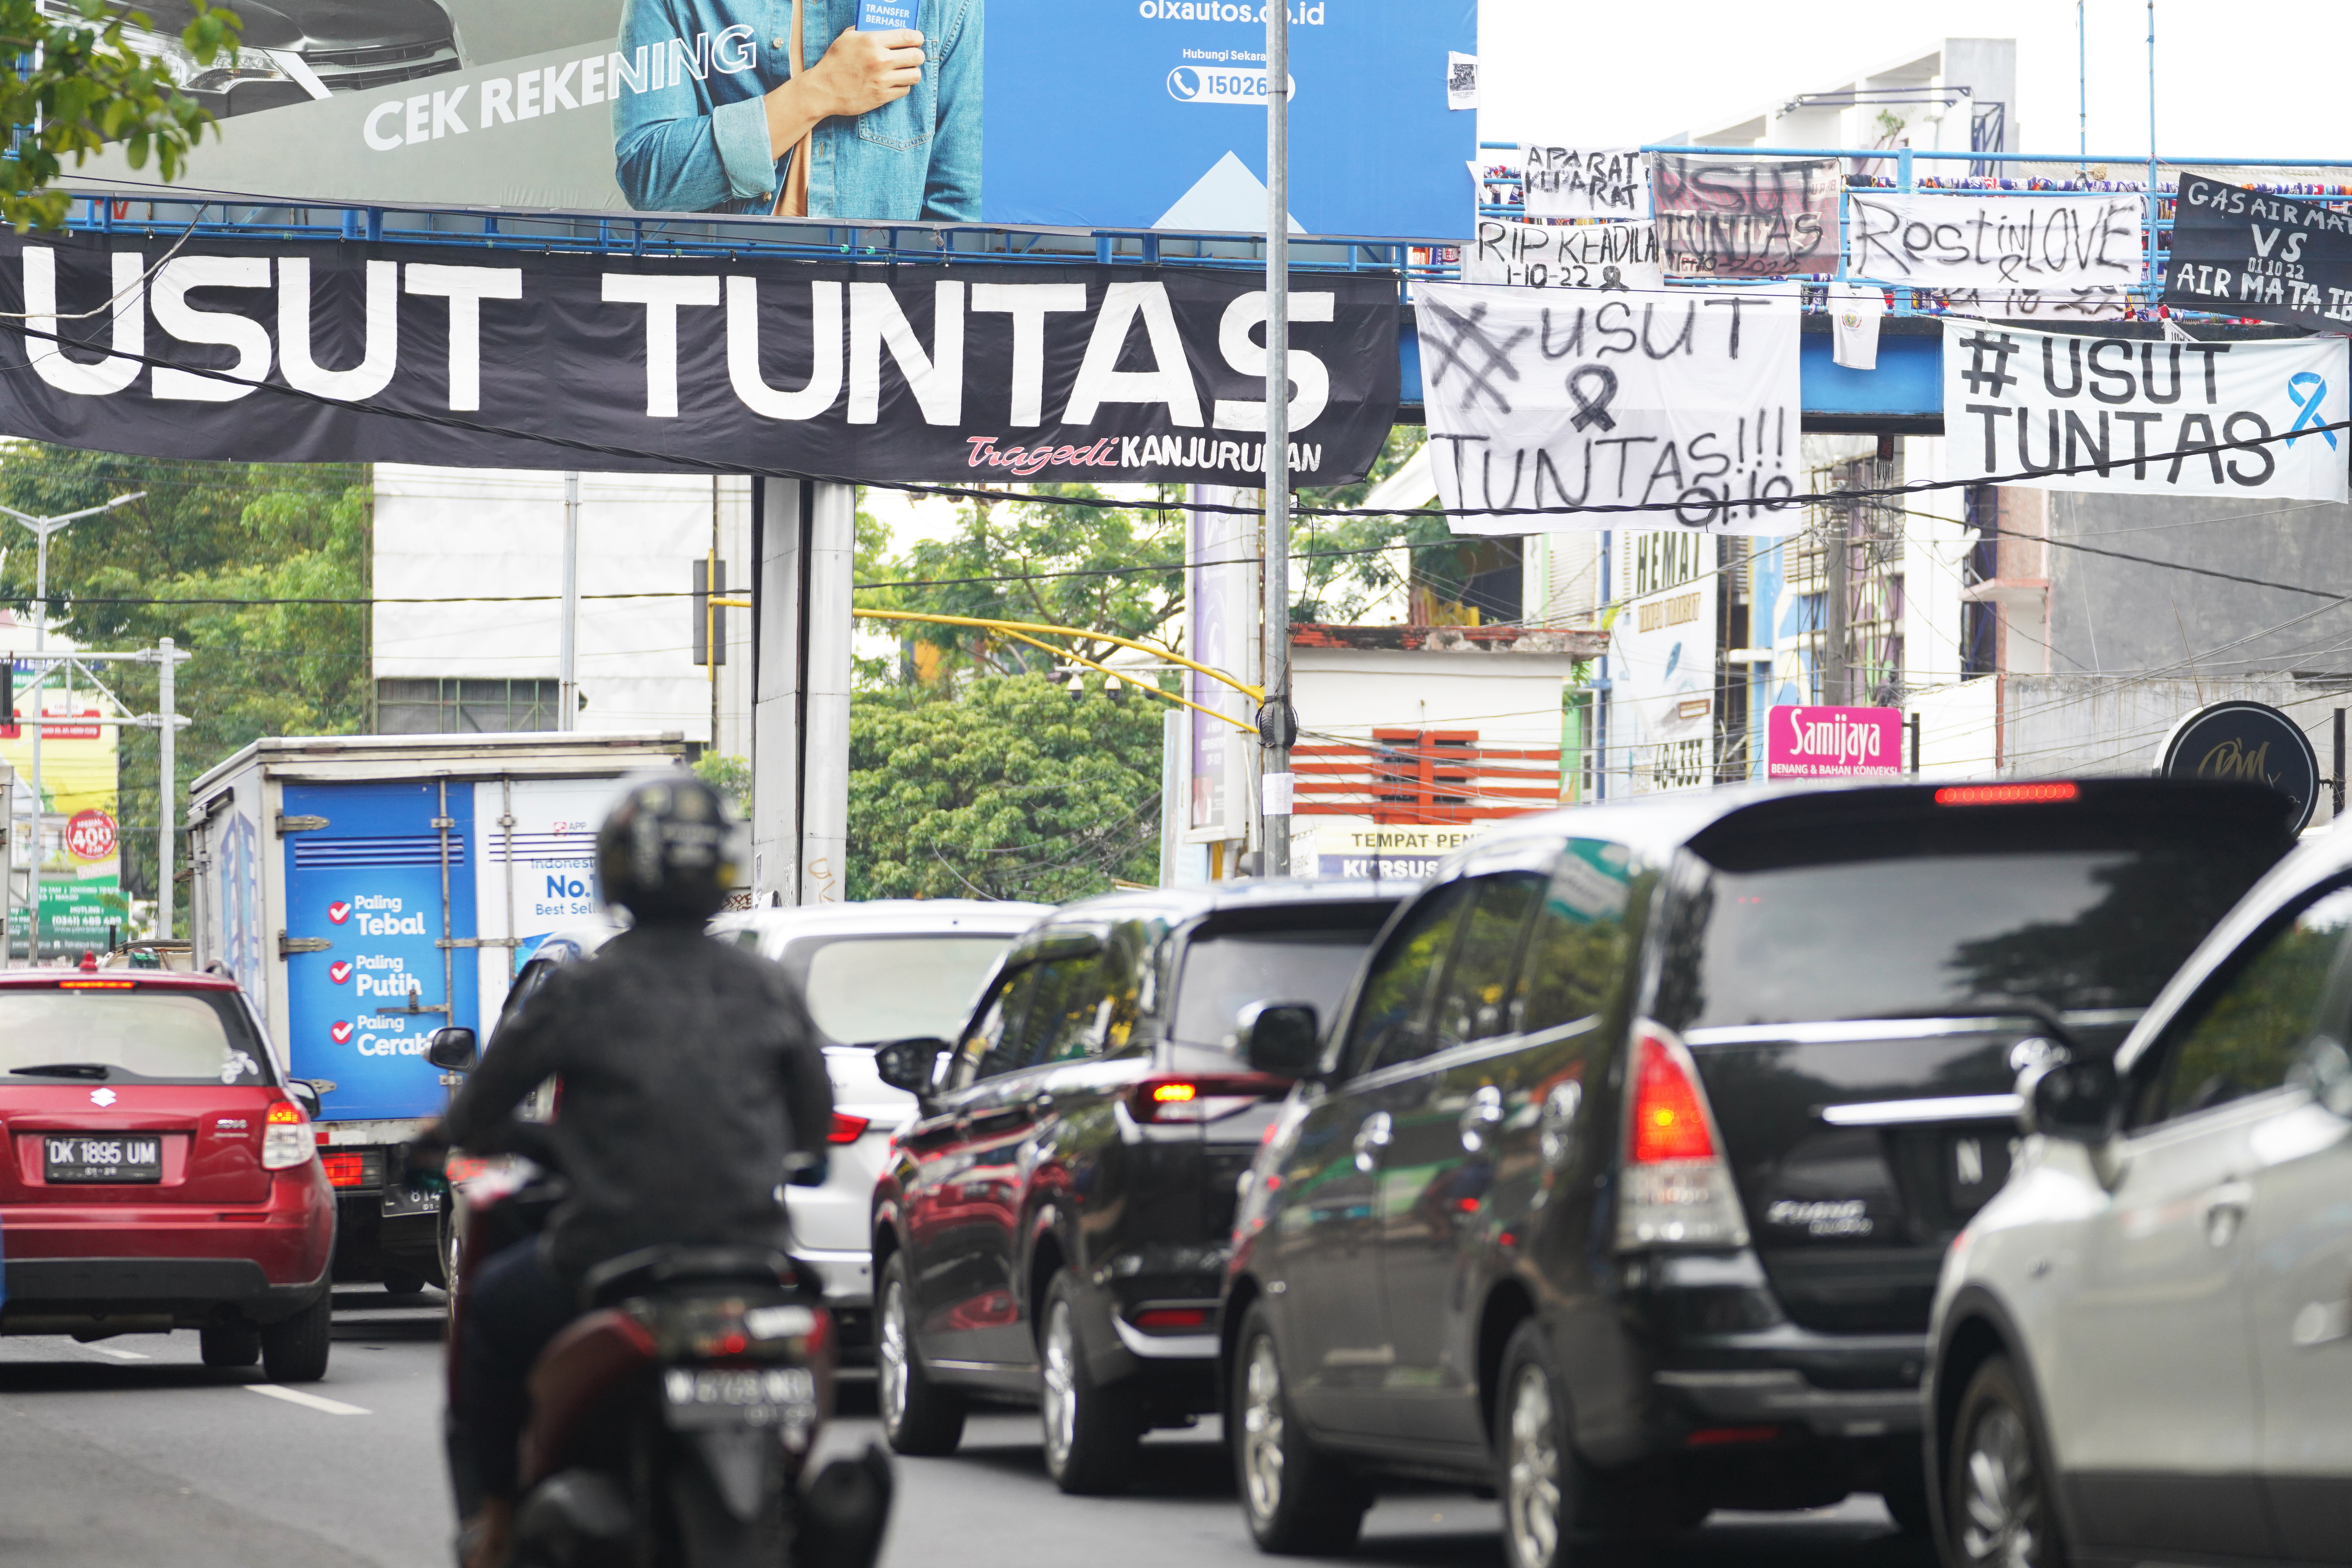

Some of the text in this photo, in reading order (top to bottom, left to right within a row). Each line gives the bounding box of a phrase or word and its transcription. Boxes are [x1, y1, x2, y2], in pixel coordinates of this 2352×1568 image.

[866, 4, 910, 18] TRANSFER
[866, 14, 906, 28] BERHASIL
[1183, 49, 1267, 61] Hubungi Sekara
[363, 24, 756, 151] CEK REKENING
[1208, 76, 1267, 96] 15026
[1528, 147, 1640, 185] APARAT
[1659, 155, 1832, 214] USUT
[2189, 182, 2352, 235] GAS AIR MAT
[1479, 222, 1549, 262] RIP
[1561, 225, 1659, 264] KEADILA
[1655, 208, 1822, 265] TUNTAS
[2027, 205, 2135, 274] LOVE
[2251, 223, 2307, 262] VS
[1507, 263, 1591, 288] 1-10-22
[2248, 257, 2304, 280] 01 10 22
[2177, 263, 2352, 322] AIR MATA IB
[23, 246, 1334, 432] USUT TUNTAS
[1541, 298, 1772, 360] USUT
[1959, 331, 2231, 405] # USUT
[967, 435, 1321, 475] Tragedi KANJURUAN
[1965, 404, 2275, 487] TUNTAS
[1431, 406, 1784, 519] TUNTAS!!!
[1790, 708, 1880, 765] Samijaya
[1771, 763, 1897, 776] BENANG & BAHAN KONVEKSI
[1352, 833, 1481, 848] TEMPAT PEN
[531, 856, 596, 869] Indonesi
[1343, 860, 1439, 879] KURSUS
[354, 895, 402, 913] Paling
[536, 904, 564, 915] Best
[355, 912, 426, 936] Tebal
[356, 955, 403, 972] Paling
[356, 973, 423, 997] Putih
[357, 1015, 405, 1033] Paling
[50, 1141, 156, 1164] DK 1895 UM
